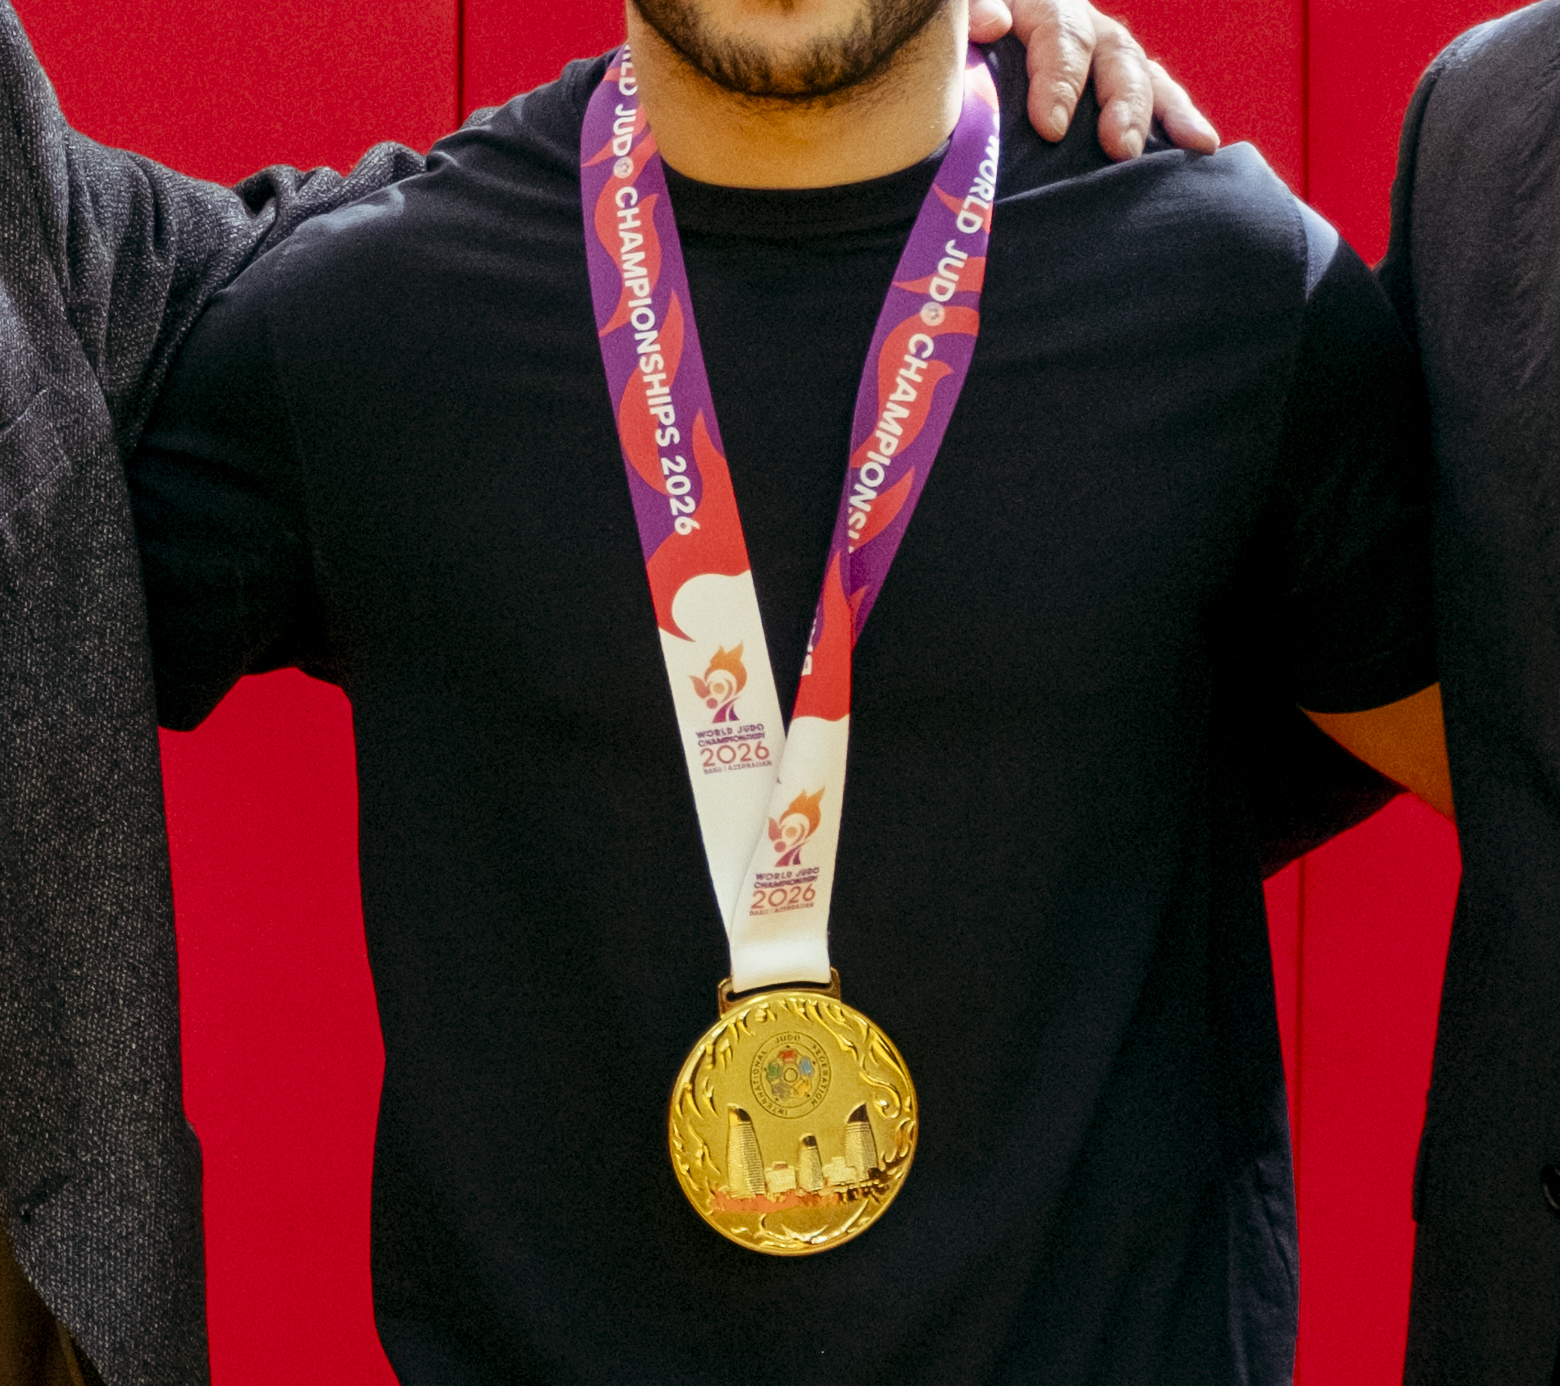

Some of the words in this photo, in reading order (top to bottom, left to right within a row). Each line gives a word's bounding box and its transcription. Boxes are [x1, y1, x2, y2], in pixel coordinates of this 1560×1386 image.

[615, 186, 680, 447] CHAMPIONSHIPS
[660, 455, 700, 535] 2026
[700, 741, 770, 767] 2026
[750, 882, 816, 909] 2026
